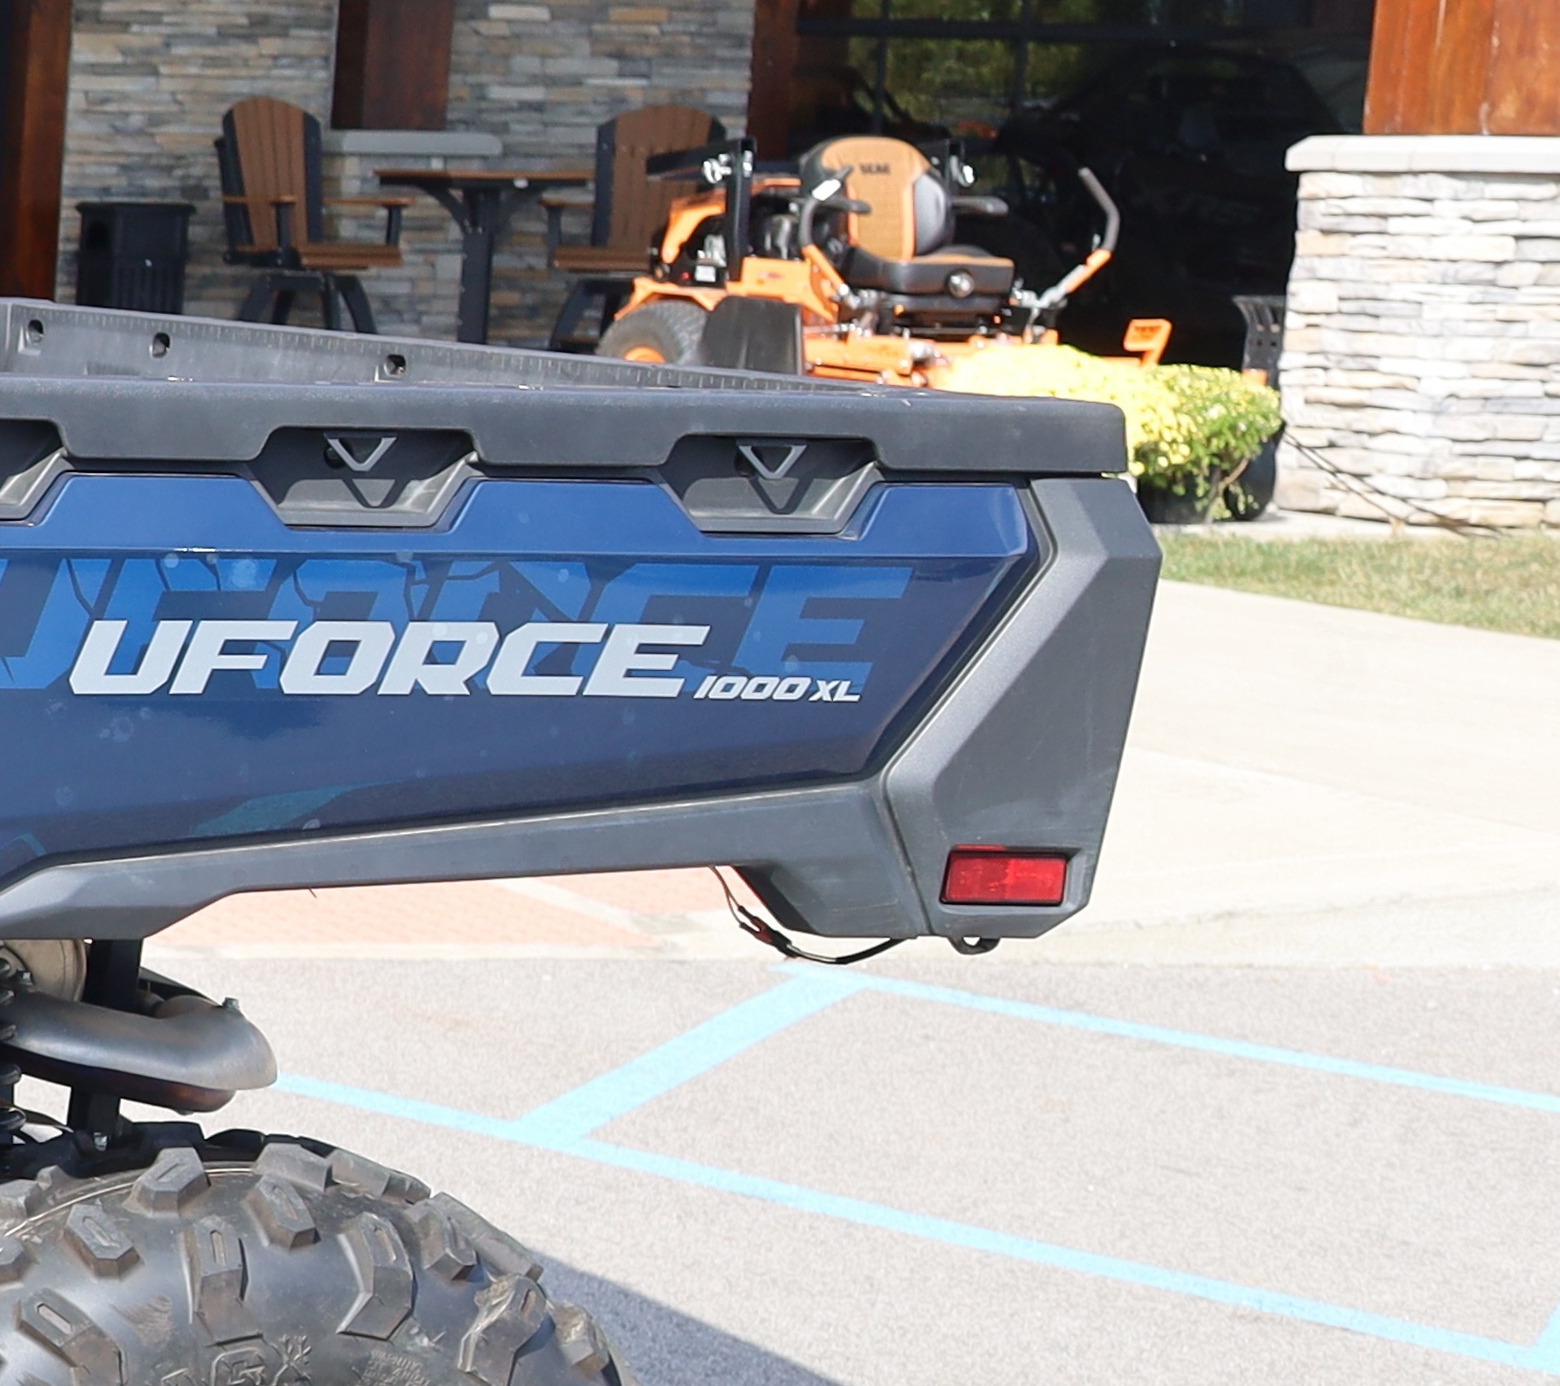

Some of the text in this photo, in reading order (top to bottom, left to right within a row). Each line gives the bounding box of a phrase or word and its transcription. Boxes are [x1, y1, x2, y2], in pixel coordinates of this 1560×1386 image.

[68, 619, 711, 698] UFORCE
[692, 675, 862, 702] 1000 XL
